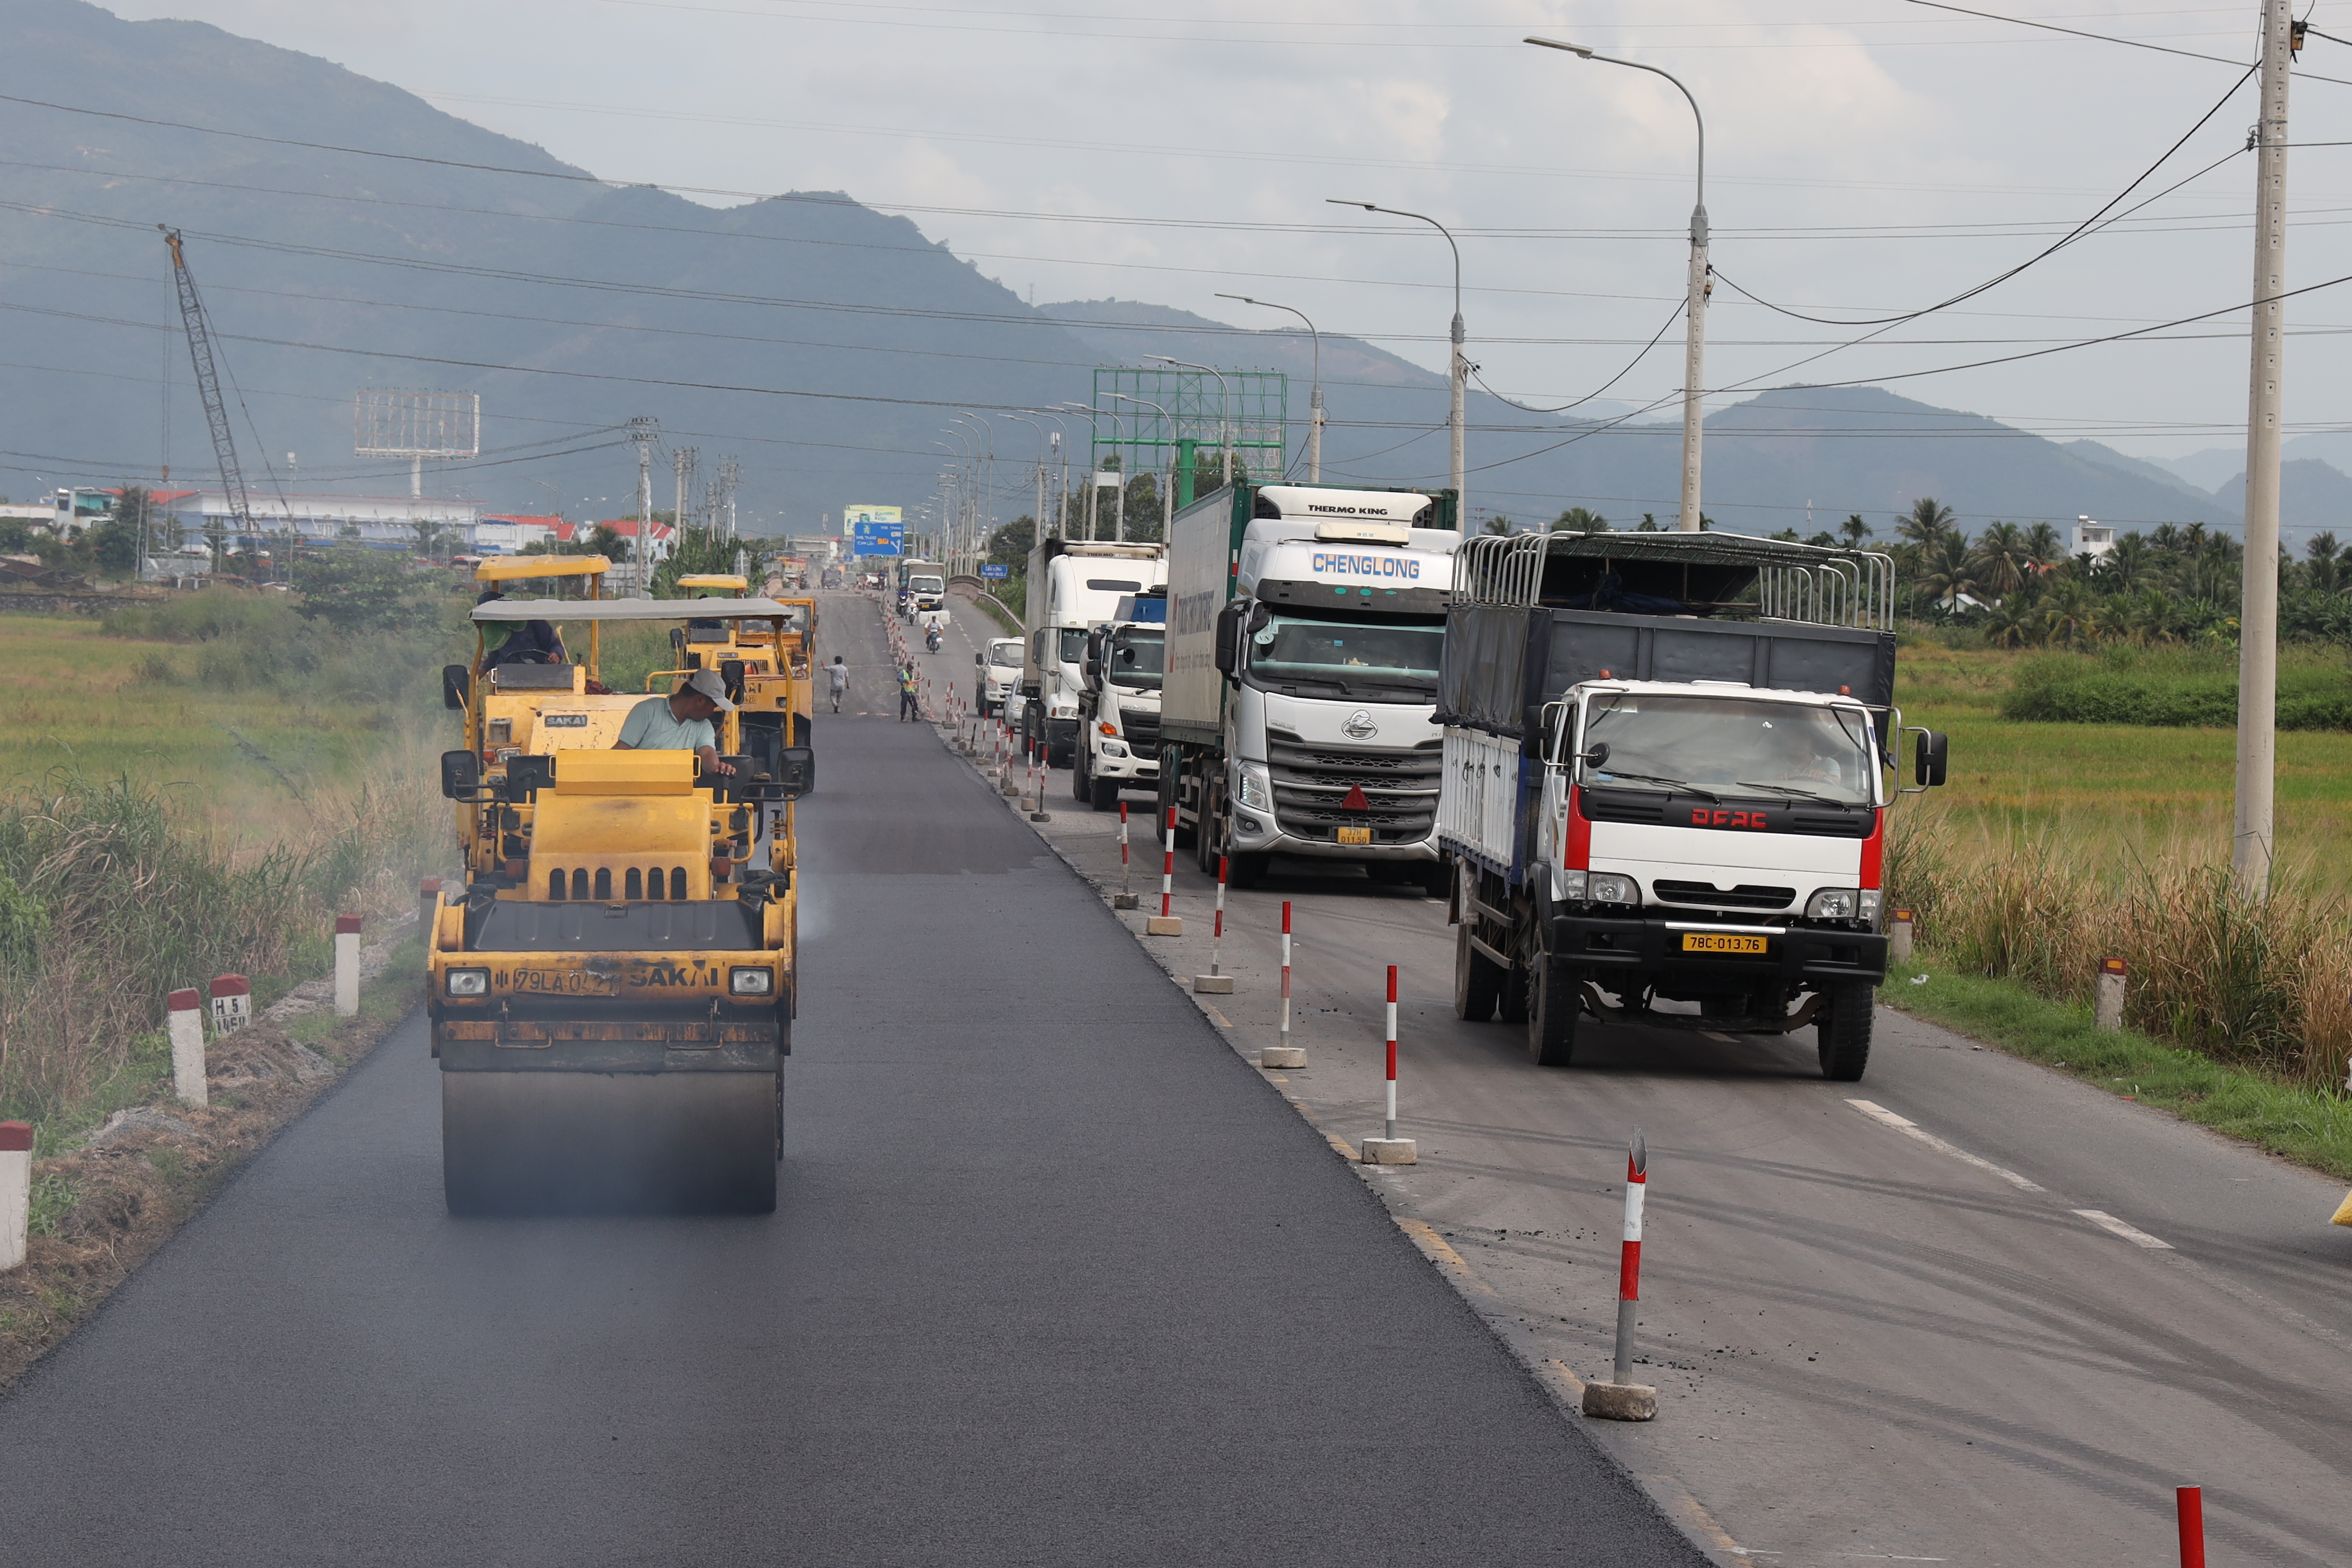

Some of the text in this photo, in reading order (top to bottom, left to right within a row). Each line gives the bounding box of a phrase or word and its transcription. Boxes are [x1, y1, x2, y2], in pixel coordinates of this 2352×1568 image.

[1308, 504, 1388, 515] THERMO KING
[1313, 553, 1420, 579] CHENGLONG
[546, 716, 586, 725] SAKAI
[1692, 808, 1767, 828] DFAC
[1690, 937, 1759, 950] 78C-013.76
